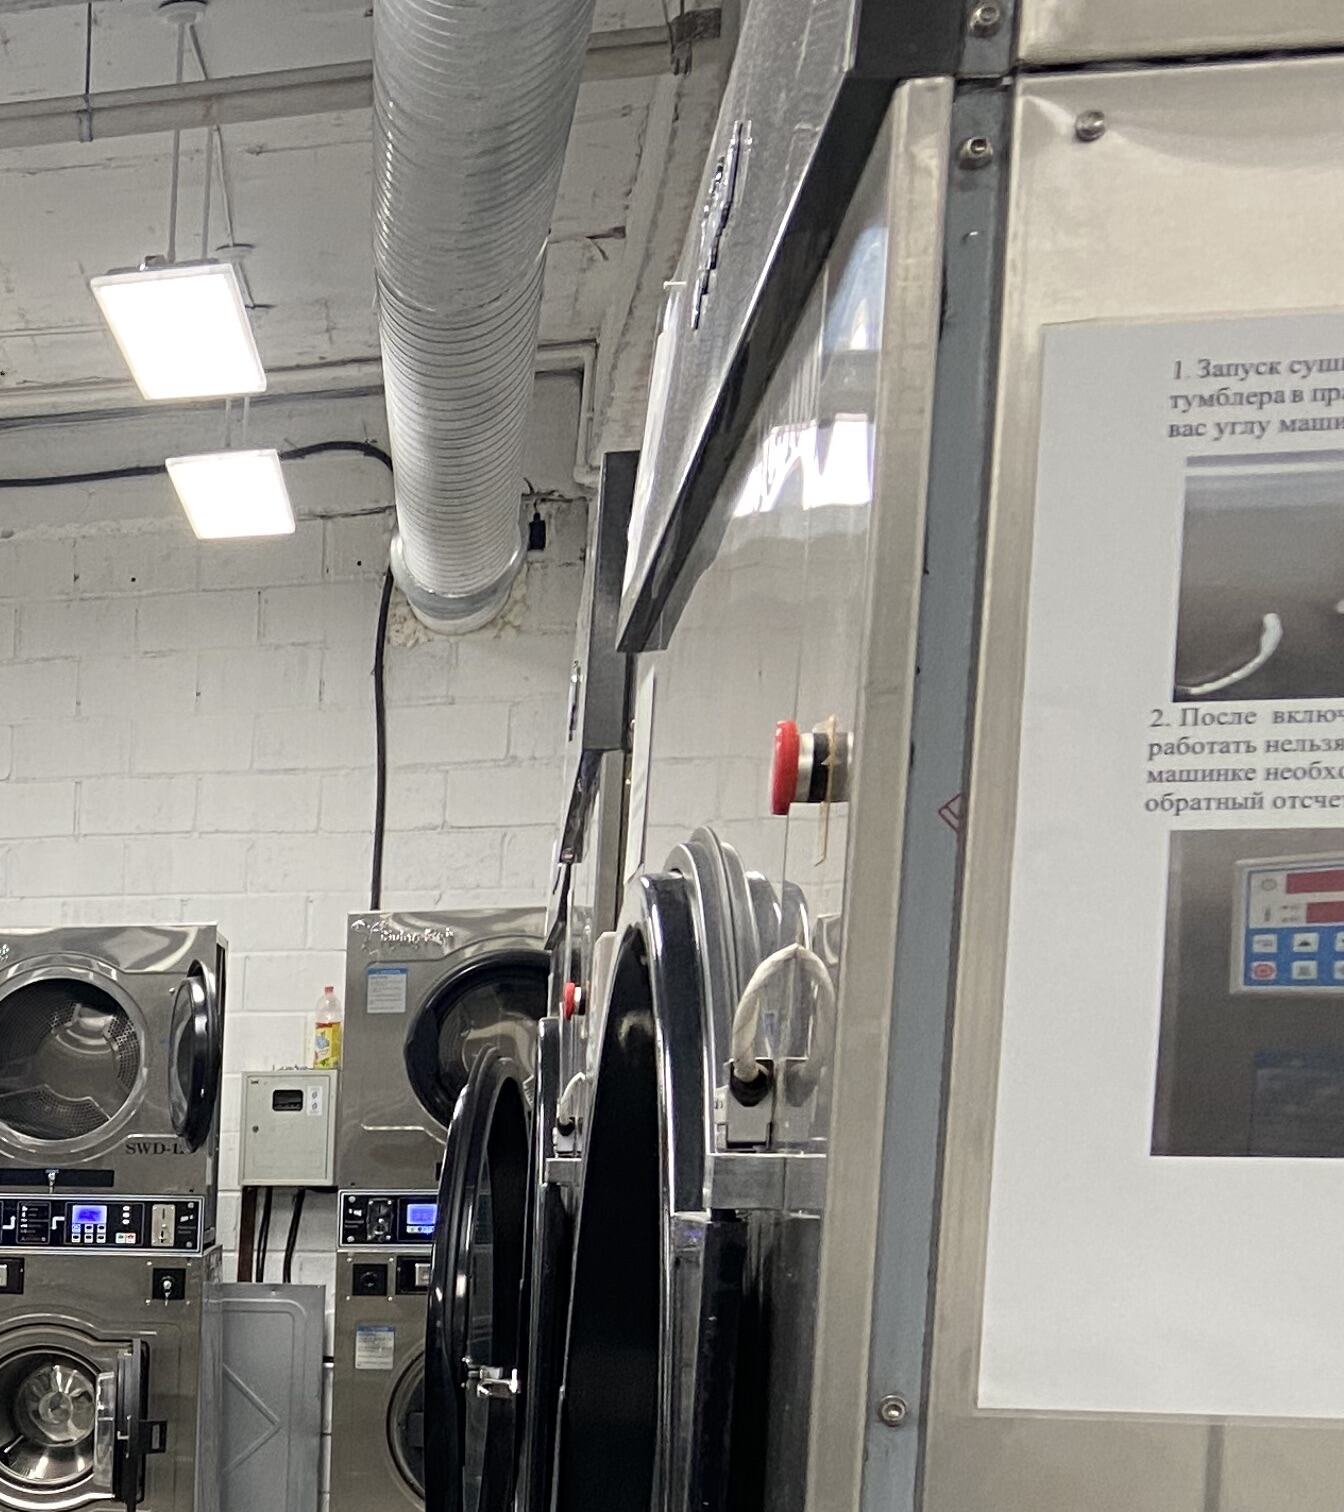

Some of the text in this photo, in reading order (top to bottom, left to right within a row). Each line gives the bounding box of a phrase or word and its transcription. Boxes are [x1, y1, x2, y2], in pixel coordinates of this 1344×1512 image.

[1198, 358, 1281, 381] Запуск
[1289, 357, 1344, 379] суш
[1169, 387, 1344, 413] тумблера в пр
[1168, 422, 1207, 438] вас
[1214, 420, 1271, 441] углу
[1150, 708, 1171, 727] 2.
[1179, 707, 1257, 727] После
[1148, 736, 1344, 761] работать нельзя
[1147, 767, 1257, 783] машинке
[1145, 791, 1344, 816] обратный отсче
